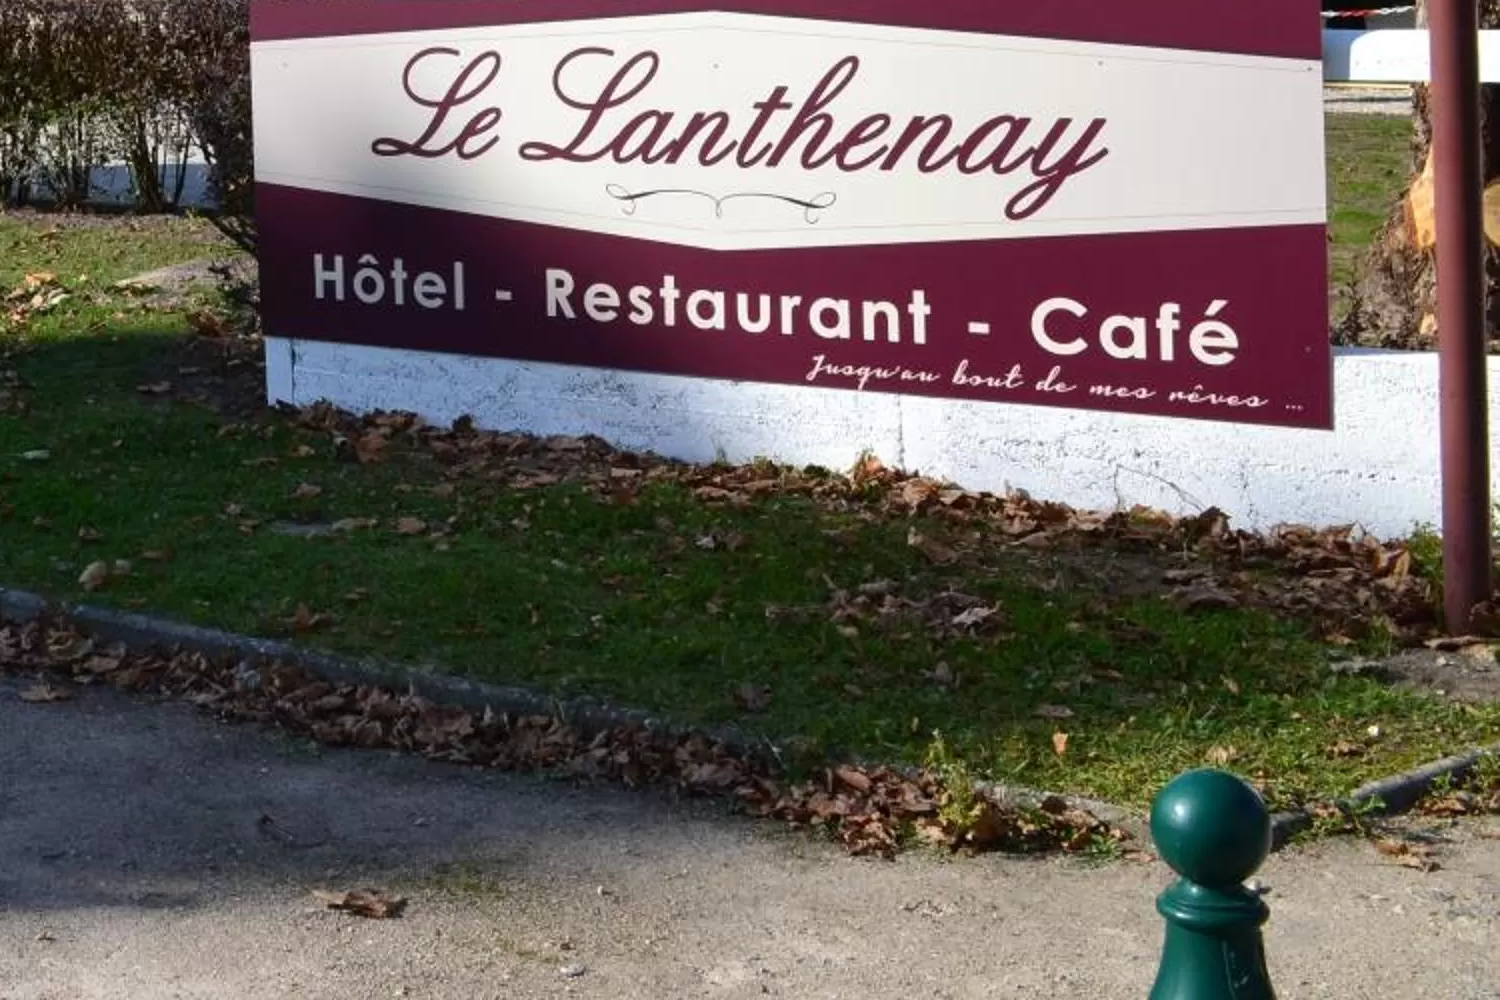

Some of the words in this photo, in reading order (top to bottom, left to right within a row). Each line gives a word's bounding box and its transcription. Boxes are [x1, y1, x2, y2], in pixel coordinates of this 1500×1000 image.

[371, 47, 502, 160] Le
[518, 47, 1109, 221] Lanthenay
[313, 253, 465, 310] Hôtel
[545, 268, 931, 345] Restaurant
[1030, 297, 1240, 366] Café
[952, 359, 1025, 389] bout
[1035, 365, 1077, 393] de
[1089, 384, 1157, 399] mes
[1168, 384, 1269, 408] rêves
